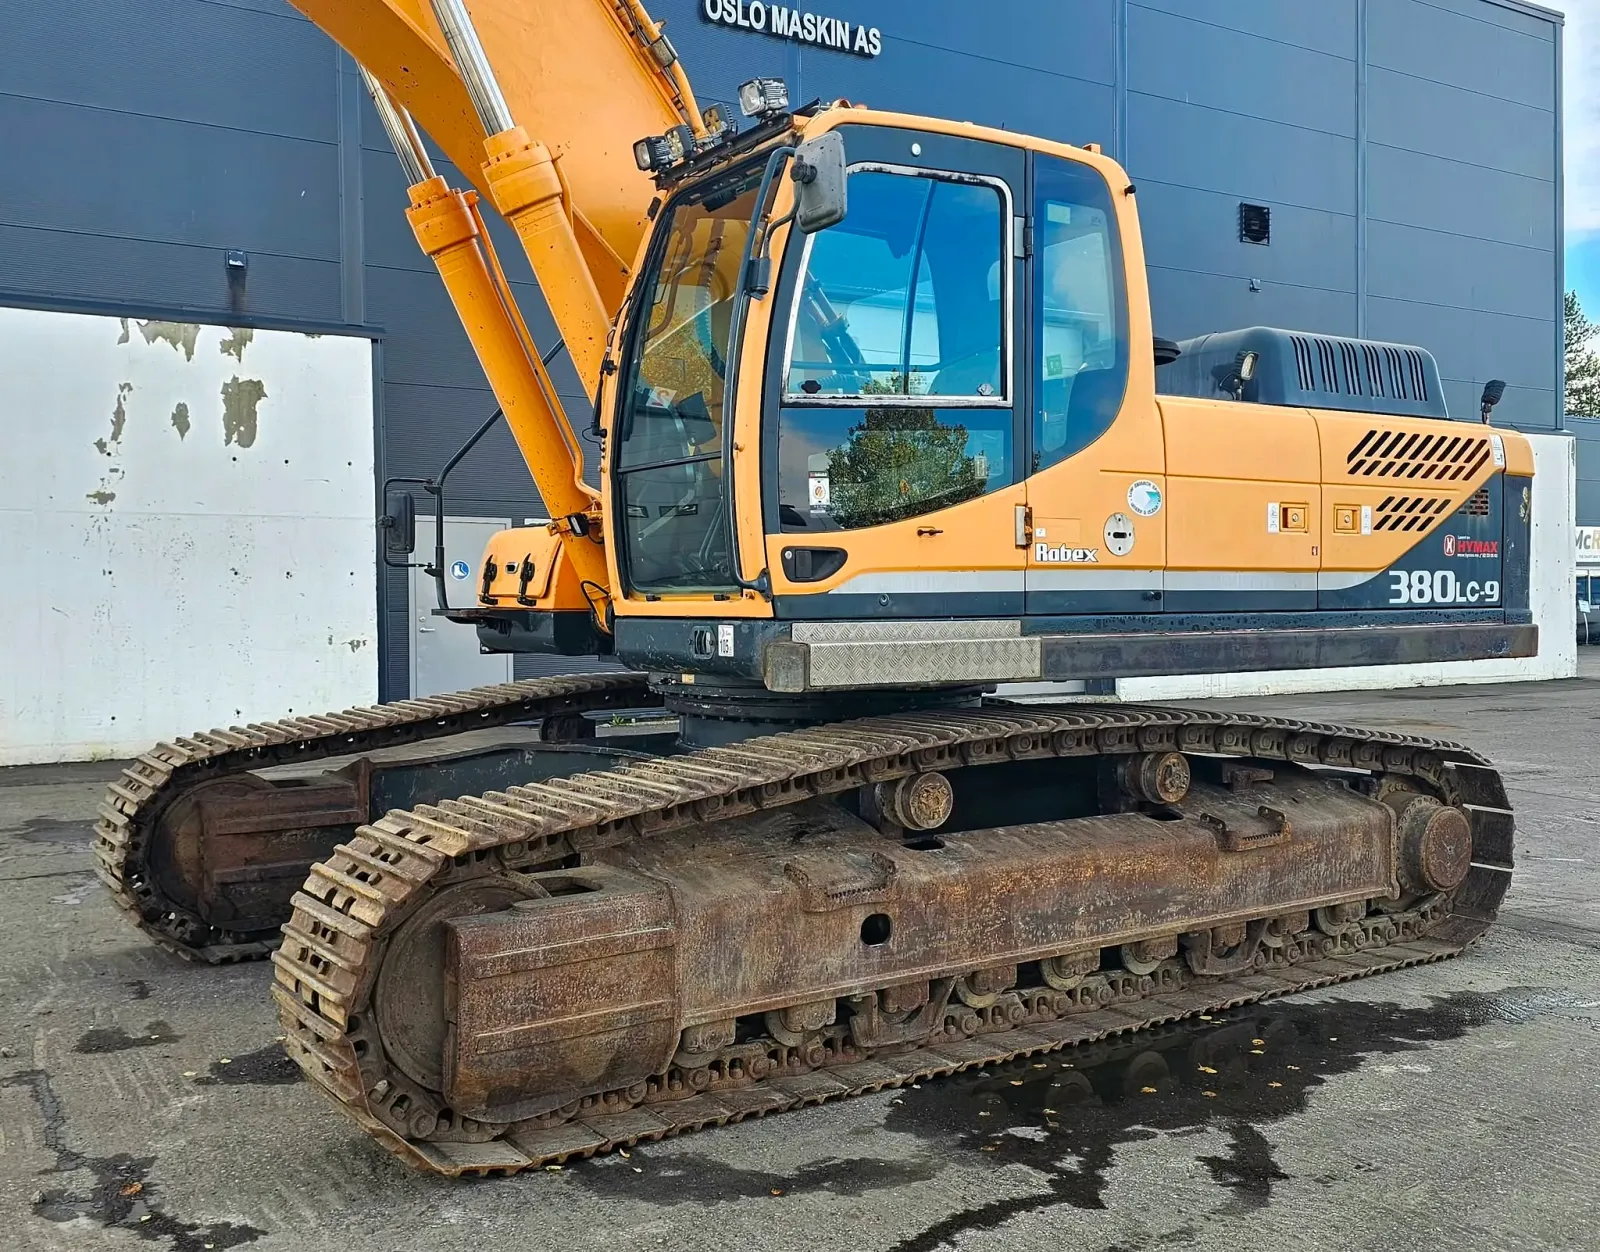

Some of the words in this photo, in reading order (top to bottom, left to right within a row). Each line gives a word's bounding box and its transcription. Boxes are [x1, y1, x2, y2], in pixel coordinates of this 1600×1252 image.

[705, 0, 766, 30] OSLO
[771, 5, 850, 50] MASKIN
[853, 25, 881, 56] AS
[1457, 540, 1498, 553] HYMAX
